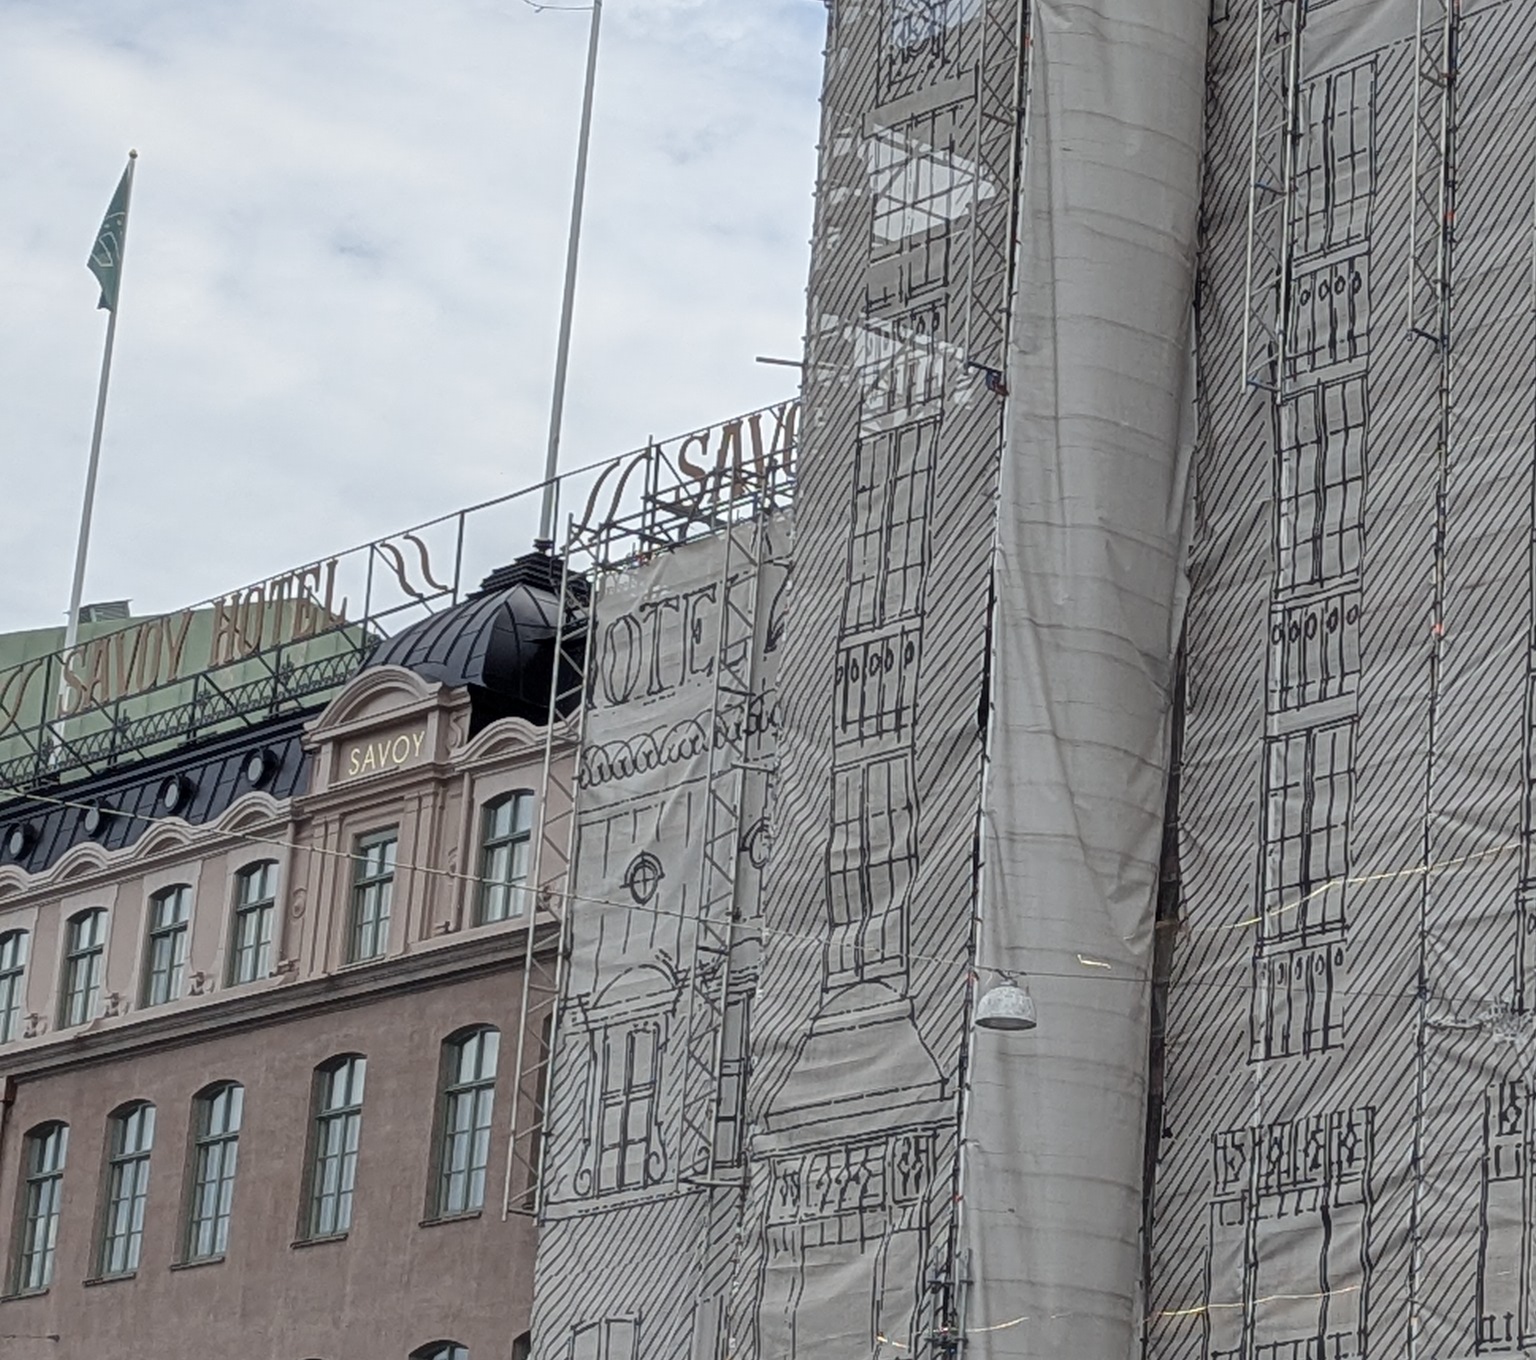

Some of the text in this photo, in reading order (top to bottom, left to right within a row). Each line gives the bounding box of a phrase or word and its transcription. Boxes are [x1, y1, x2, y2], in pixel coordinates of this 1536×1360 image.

[57, 558, 348, 717] SAVOY HOTEL
[348, 730, 426, 776] SAVOY
